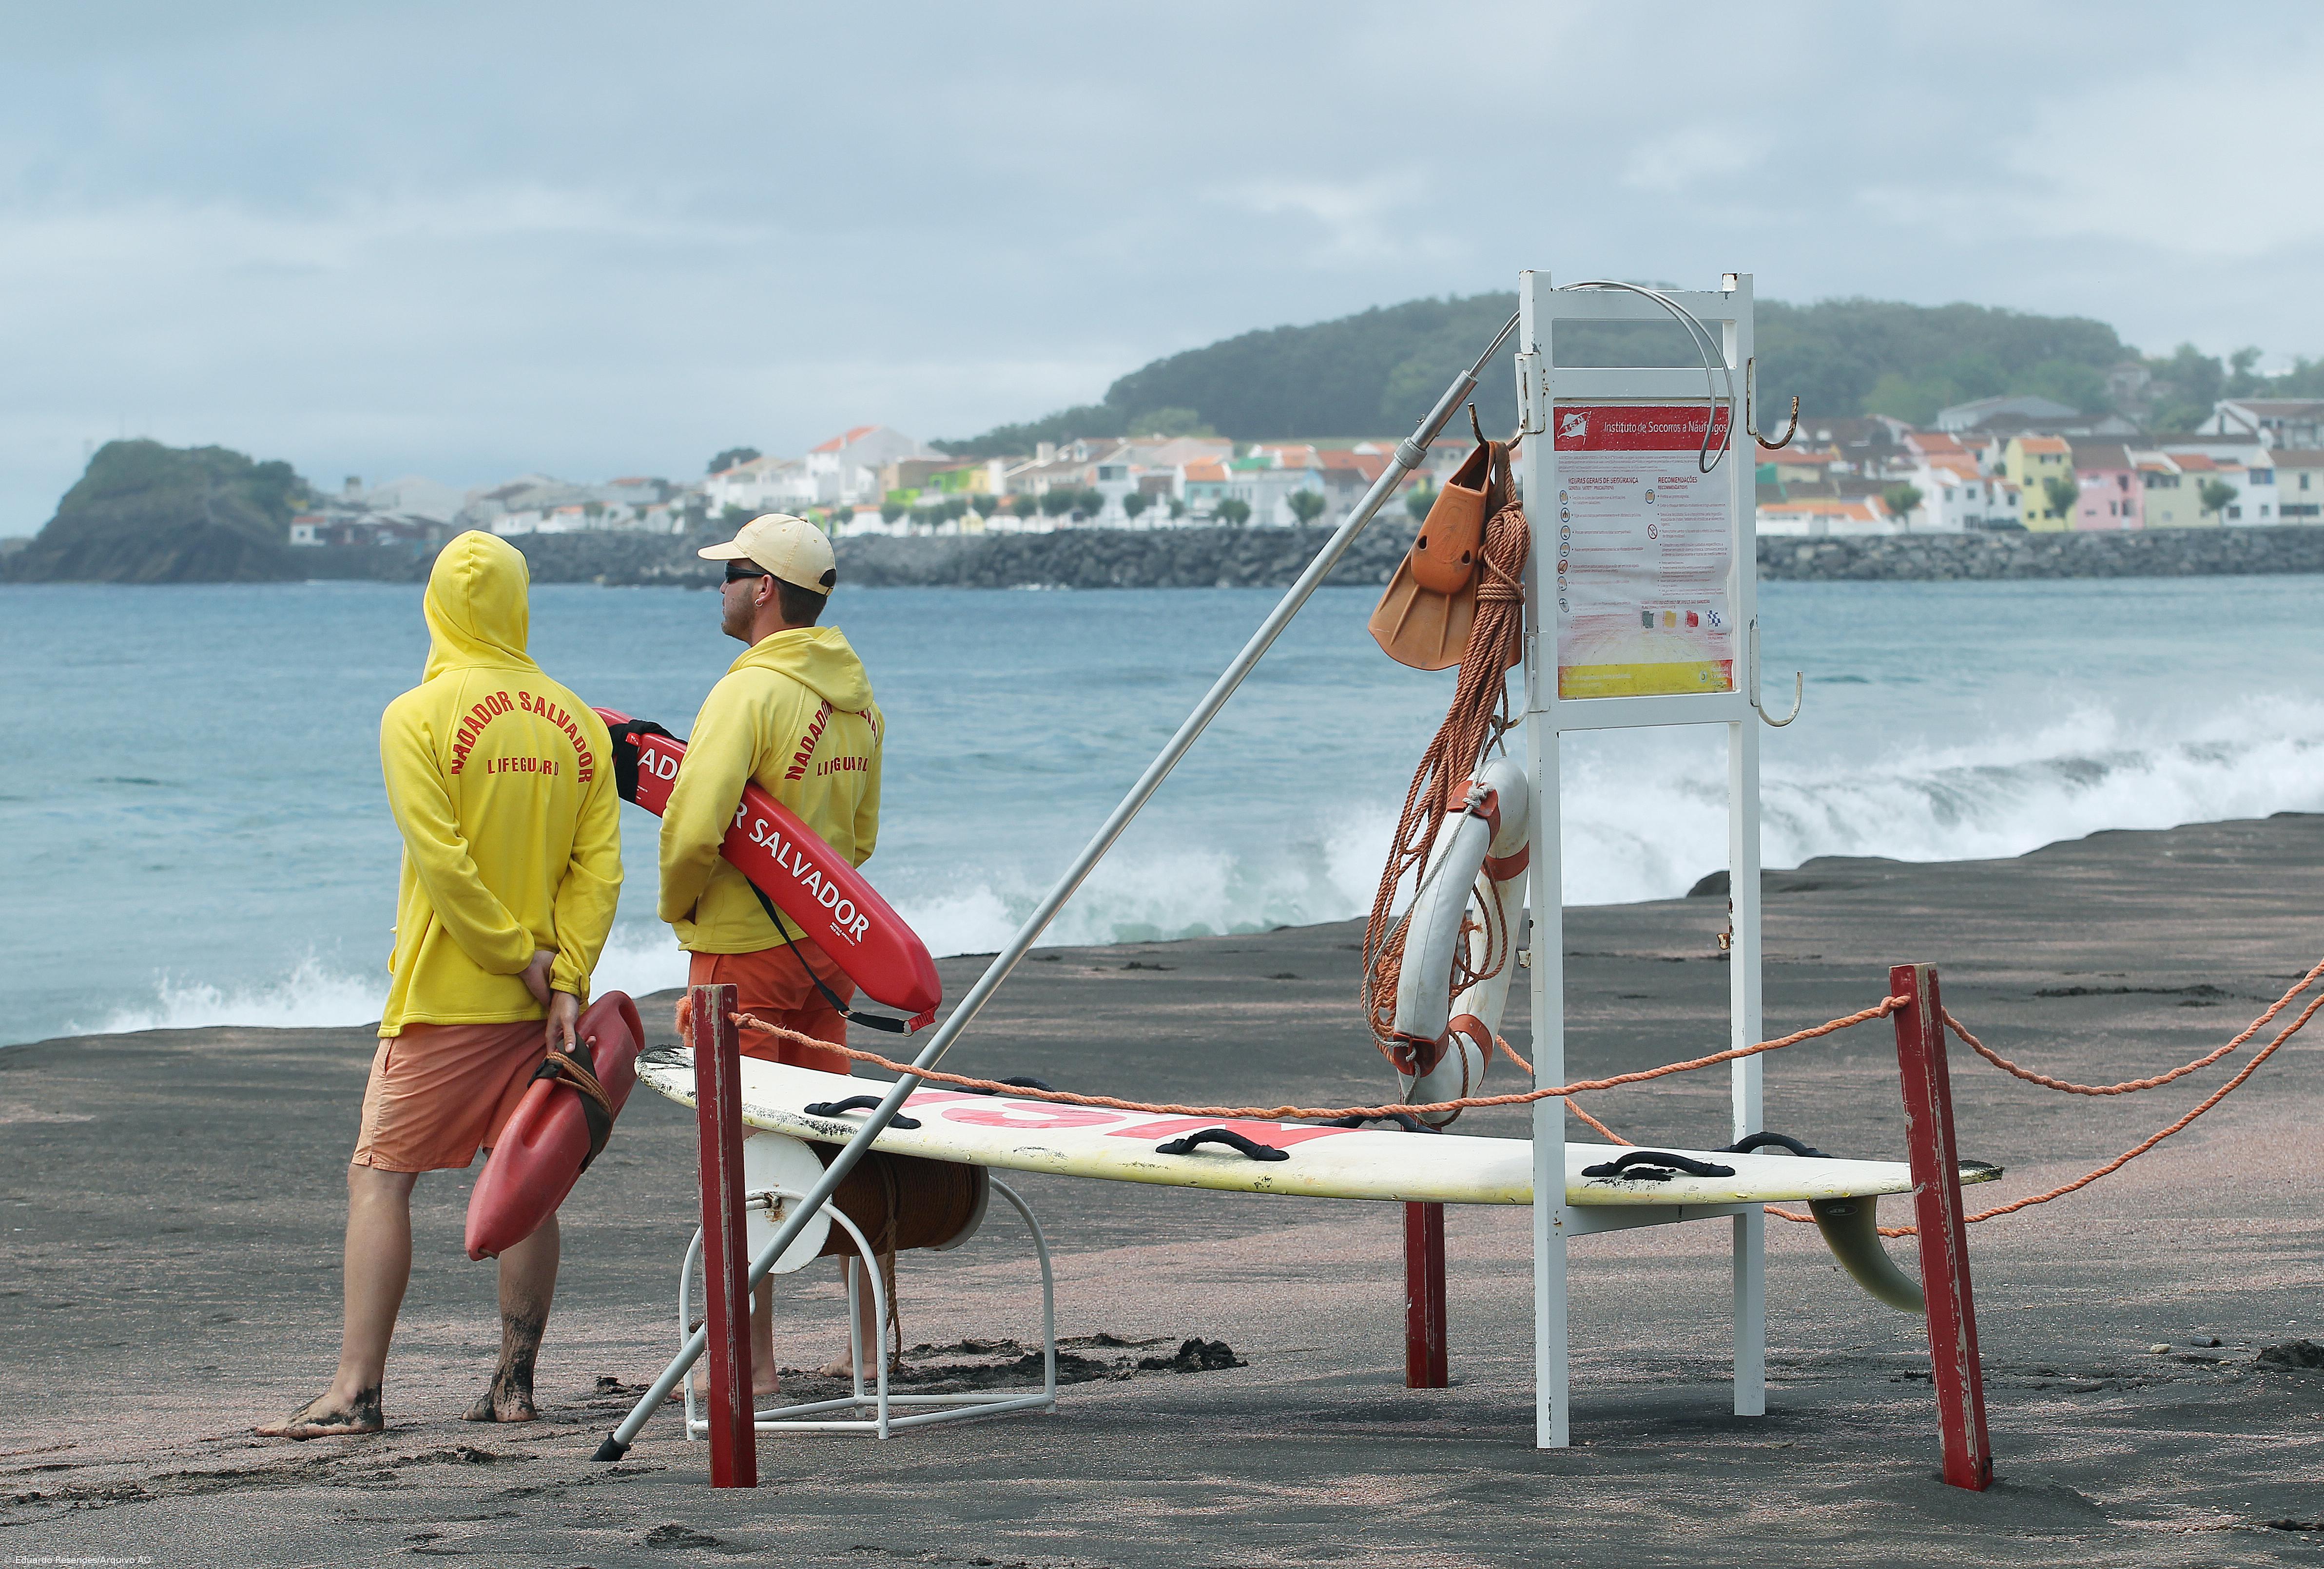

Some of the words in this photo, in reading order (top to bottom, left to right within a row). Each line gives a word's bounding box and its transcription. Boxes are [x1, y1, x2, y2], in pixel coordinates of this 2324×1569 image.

[1604, 422, 1636, 433] Instituto
[1638, 422, 1647, 433] de
[1648, 421, 1681, 433] Socorros
[1688, 420, 1727, 435] Náufgos
[451, 691, 515, 775] NADADOR
[518, 691, 594, 783] SALVADOR
[748, 818, 870, 943] SALVADOR
